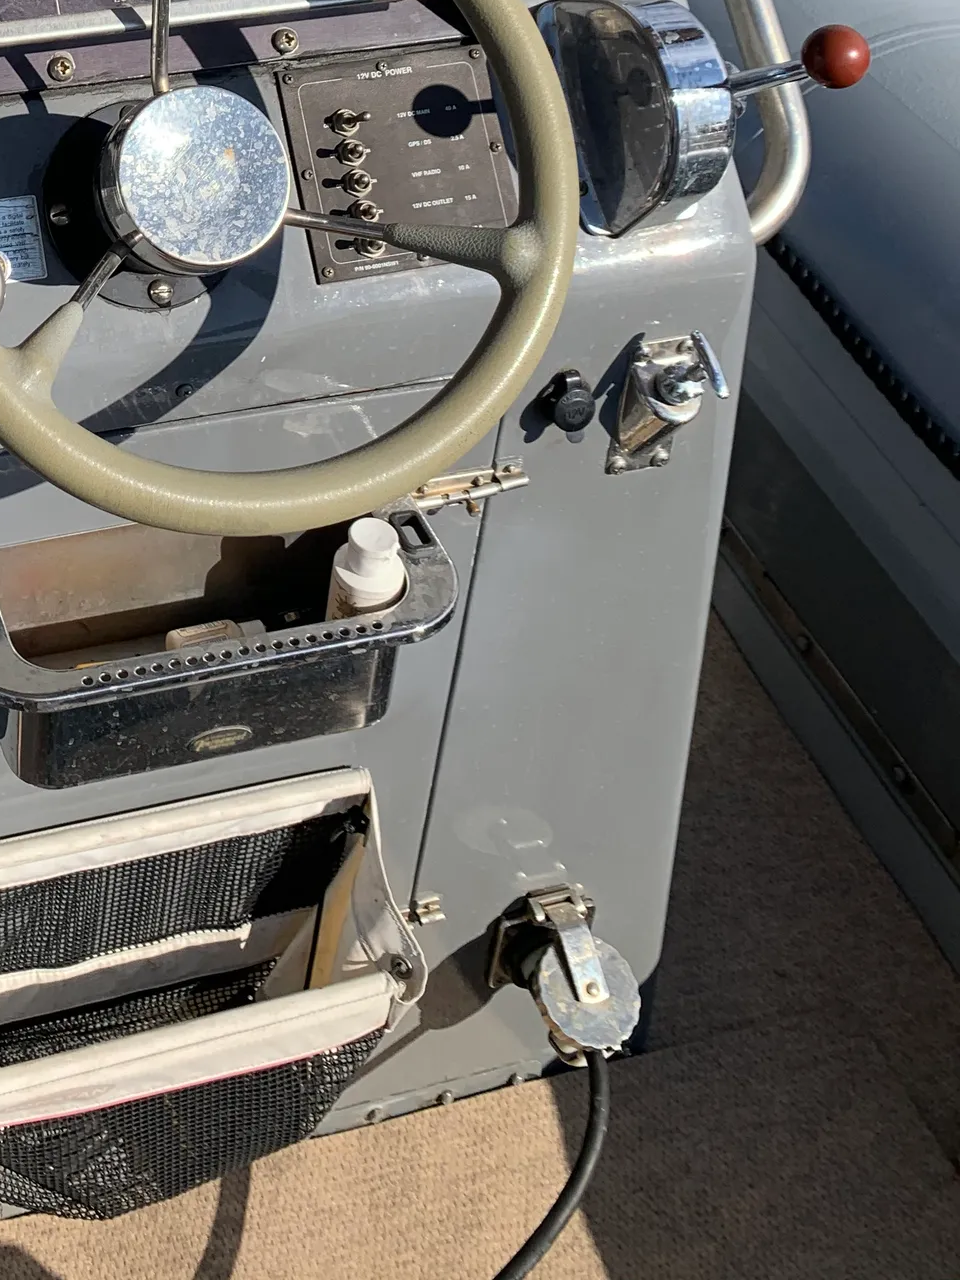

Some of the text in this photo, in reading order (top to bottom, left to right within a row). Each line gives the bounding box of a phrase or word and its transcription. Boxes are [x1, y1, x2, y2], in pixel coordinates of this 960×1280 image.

[356, 66, 412, 80] 12V DC POWER
[423, 168, 441, 176] RADIO
[431, 197, 453, 206] OUTLET
[565, 407, 586, 420] 12V
